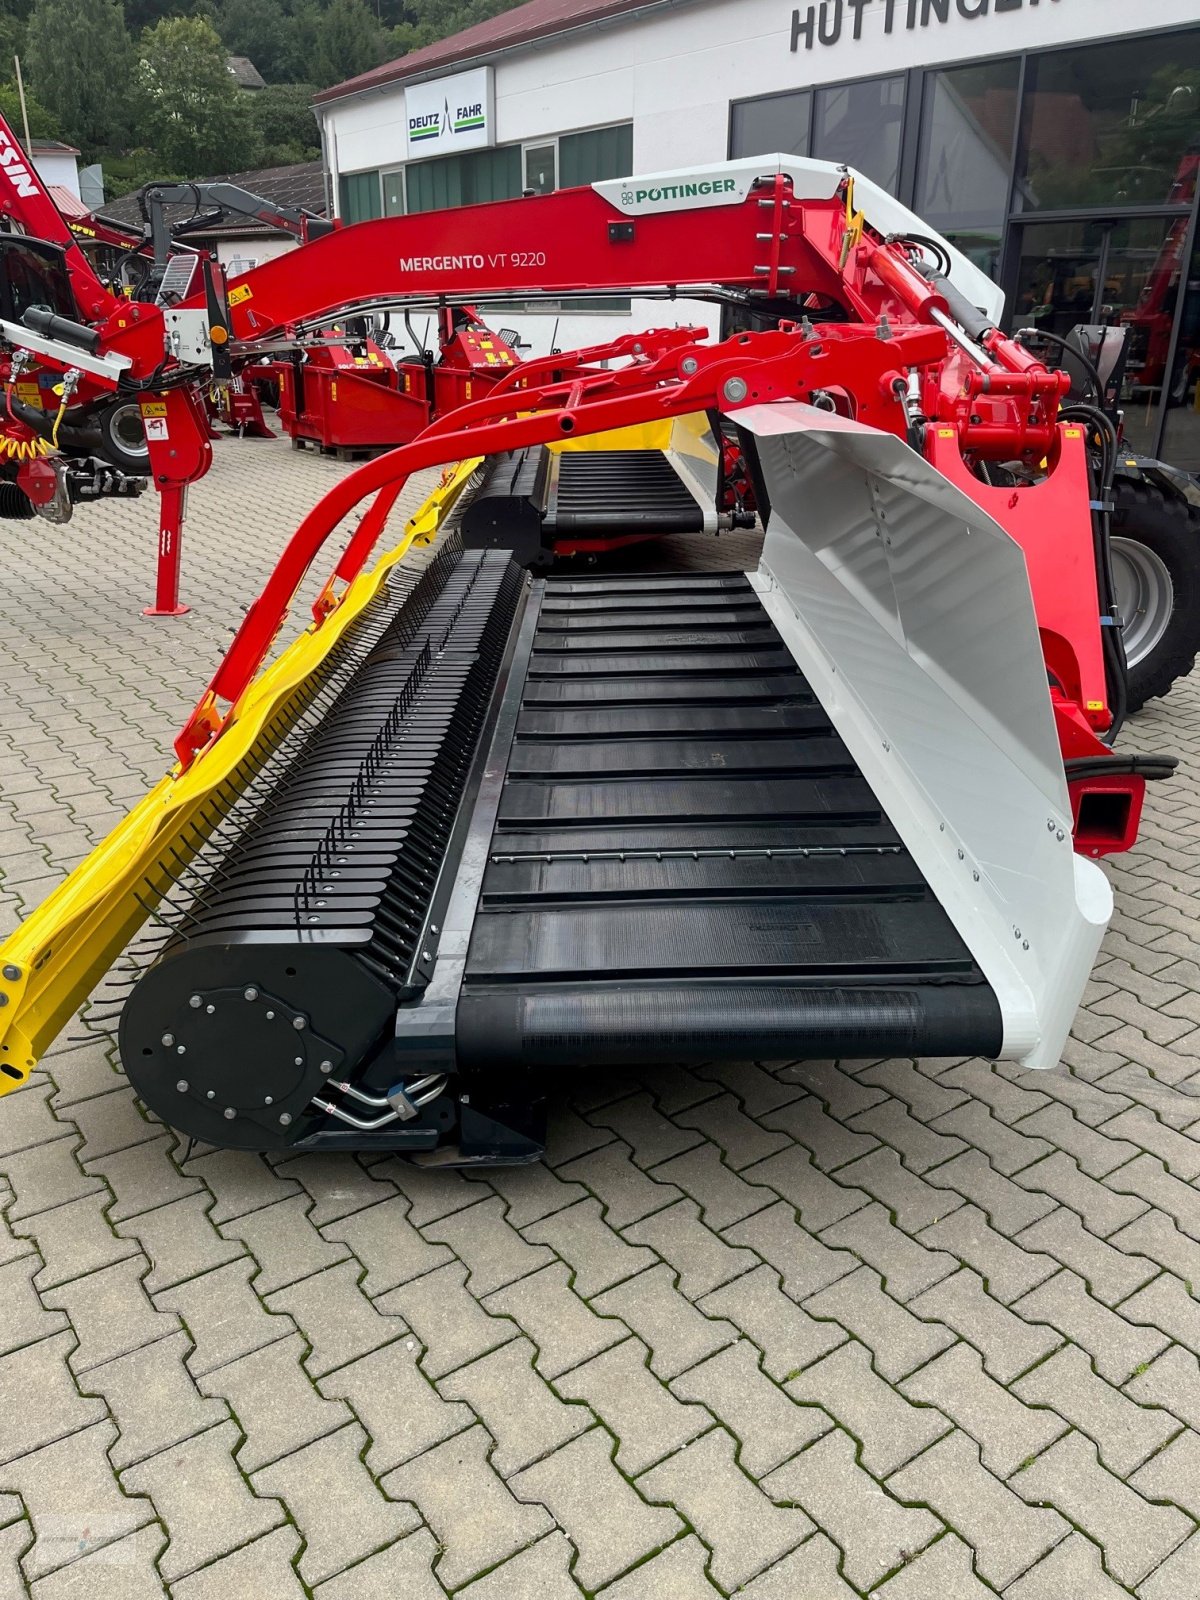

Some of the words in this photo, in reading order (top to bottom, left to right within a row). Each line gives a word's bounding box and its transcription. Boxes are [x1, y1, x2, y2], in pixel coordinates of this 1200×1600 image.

[787, 0, 1060, 52] HÜTTIN
[409, 113, 439, 130] DEUTZ
[457, 103, 482, 120] FAHR
[636, 179, 736, 203] PÖTTINGER
[400, 254, 485, 272] MERGENTO
[488, 254, 507, 268] VT
[511, 252, 546, 267] 9220
